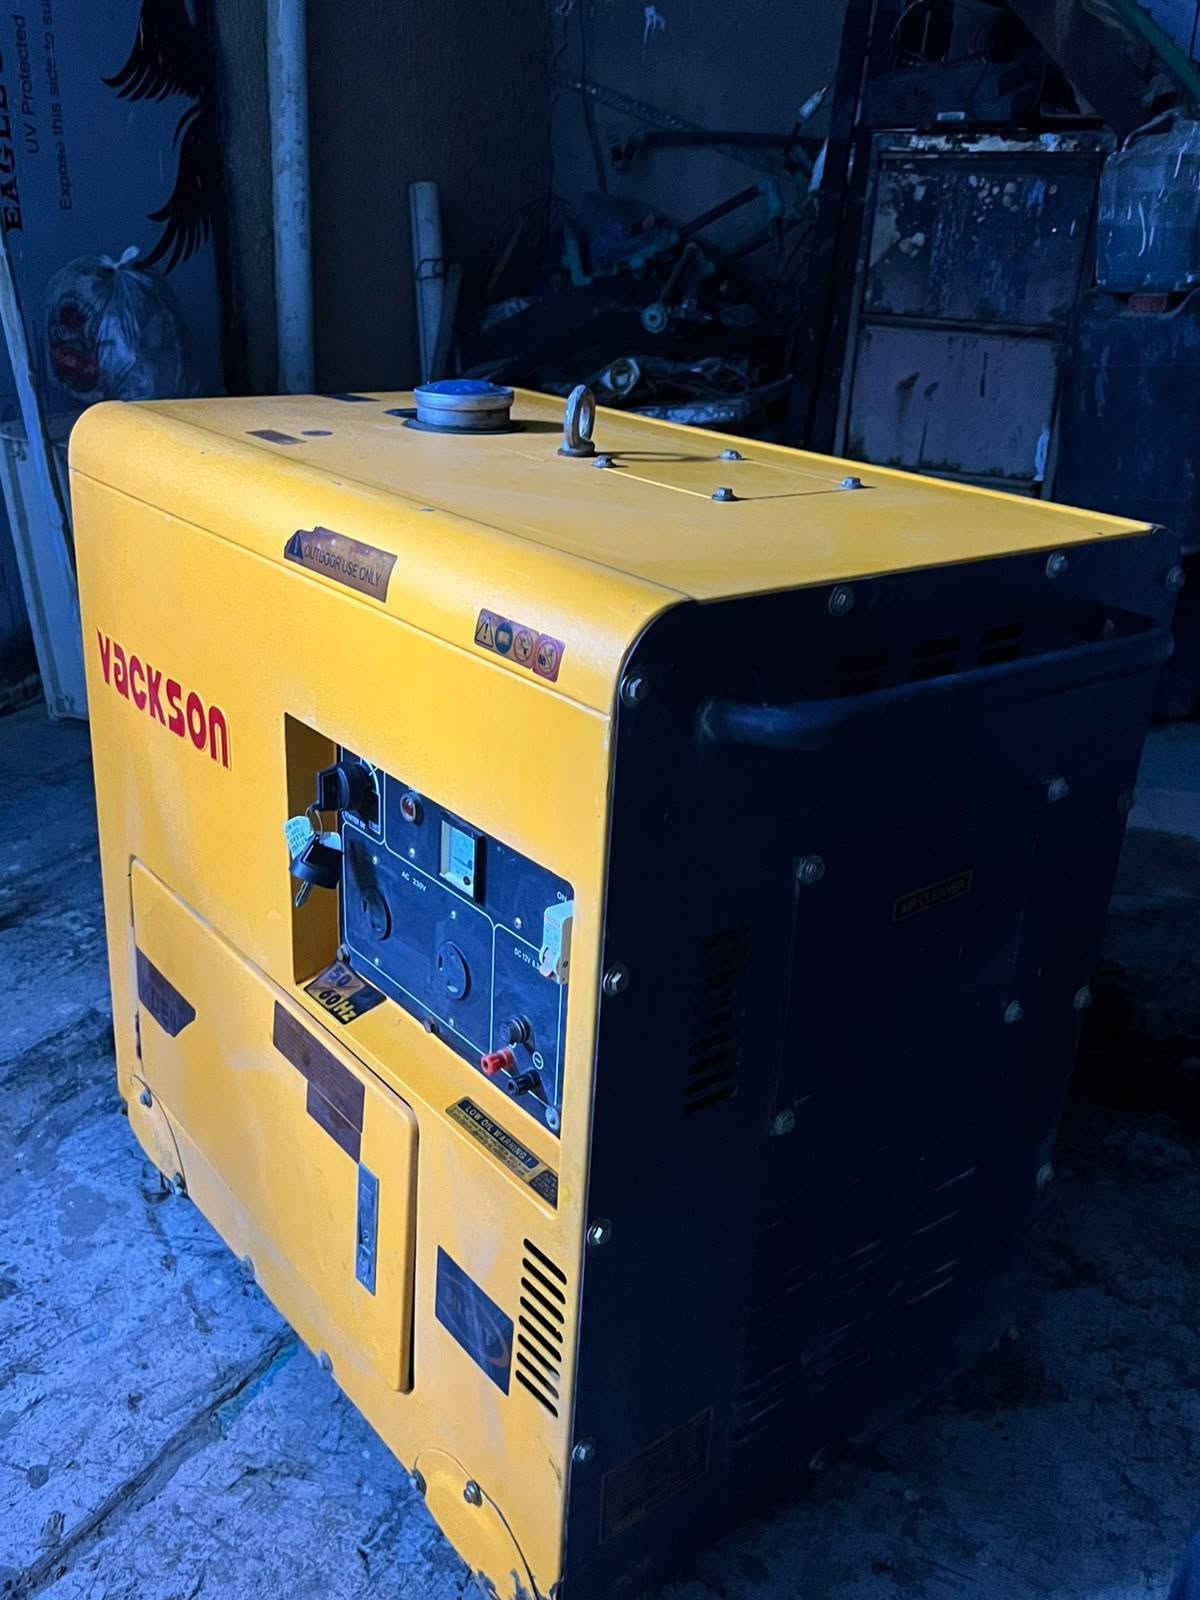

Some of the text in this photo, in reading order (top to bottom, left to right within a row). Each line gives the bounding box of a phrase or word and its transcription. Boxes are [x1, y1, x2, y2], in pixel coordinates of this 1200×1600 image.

[13, 14, 39, 154] UV Protected
[51, 103, 64, 135] this
[57, 141, 72, 210] Expose
[304, 544, 382, 587] OUTDOOR USE ONLY
[465, 1104, 481, 1121] LOW
